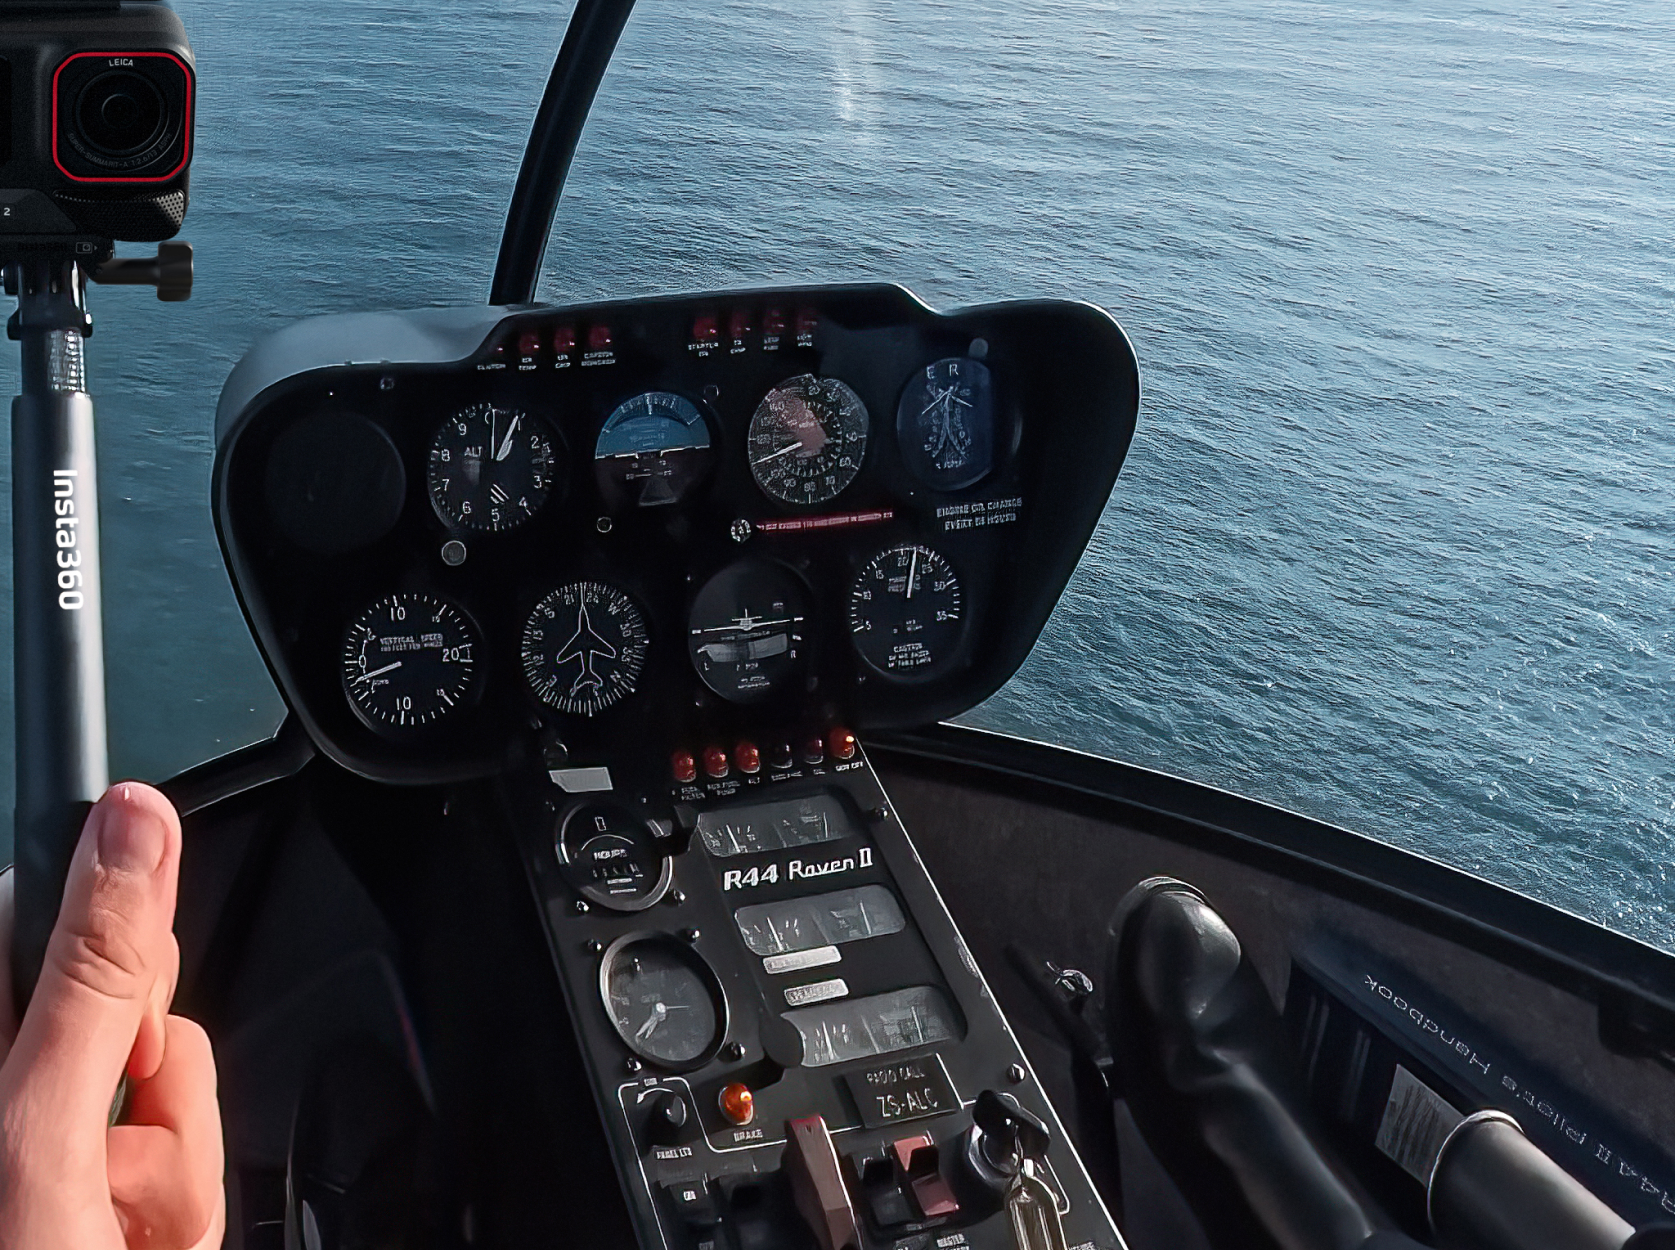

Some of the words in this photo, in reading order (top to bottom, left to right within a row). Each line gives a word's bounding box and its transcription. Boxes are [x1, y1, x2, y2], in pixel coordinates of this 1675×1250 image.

[108, 58, 134, 67] LEICA
[3, 207, 11, 216] 2
[457, 423, 467, 436] 9
[530, 435, 540, 449] 2
[441, 448, 451, 462] 8
[441, 478, 450, 492] 7
[533, 475, 543, 489] 3
[462, 501, 472, 515] 6
[518, 496, 528, 508] 4
[490, 508, 500, 522] 5
[53, 469, 85, 610] Insta360
[390, 606, 406, 622] 10
[358, 654, 367, 668] 0
[442, 646, 460, 662] 20
[395, 696, 412, 711] 10
[723, 863, 779, 891] R44
[789, 857, 855, 881] Raven
[1365, 974, 1492, 1075] Handbook
[876, 1087, 938, 1118] ZS-ALC
